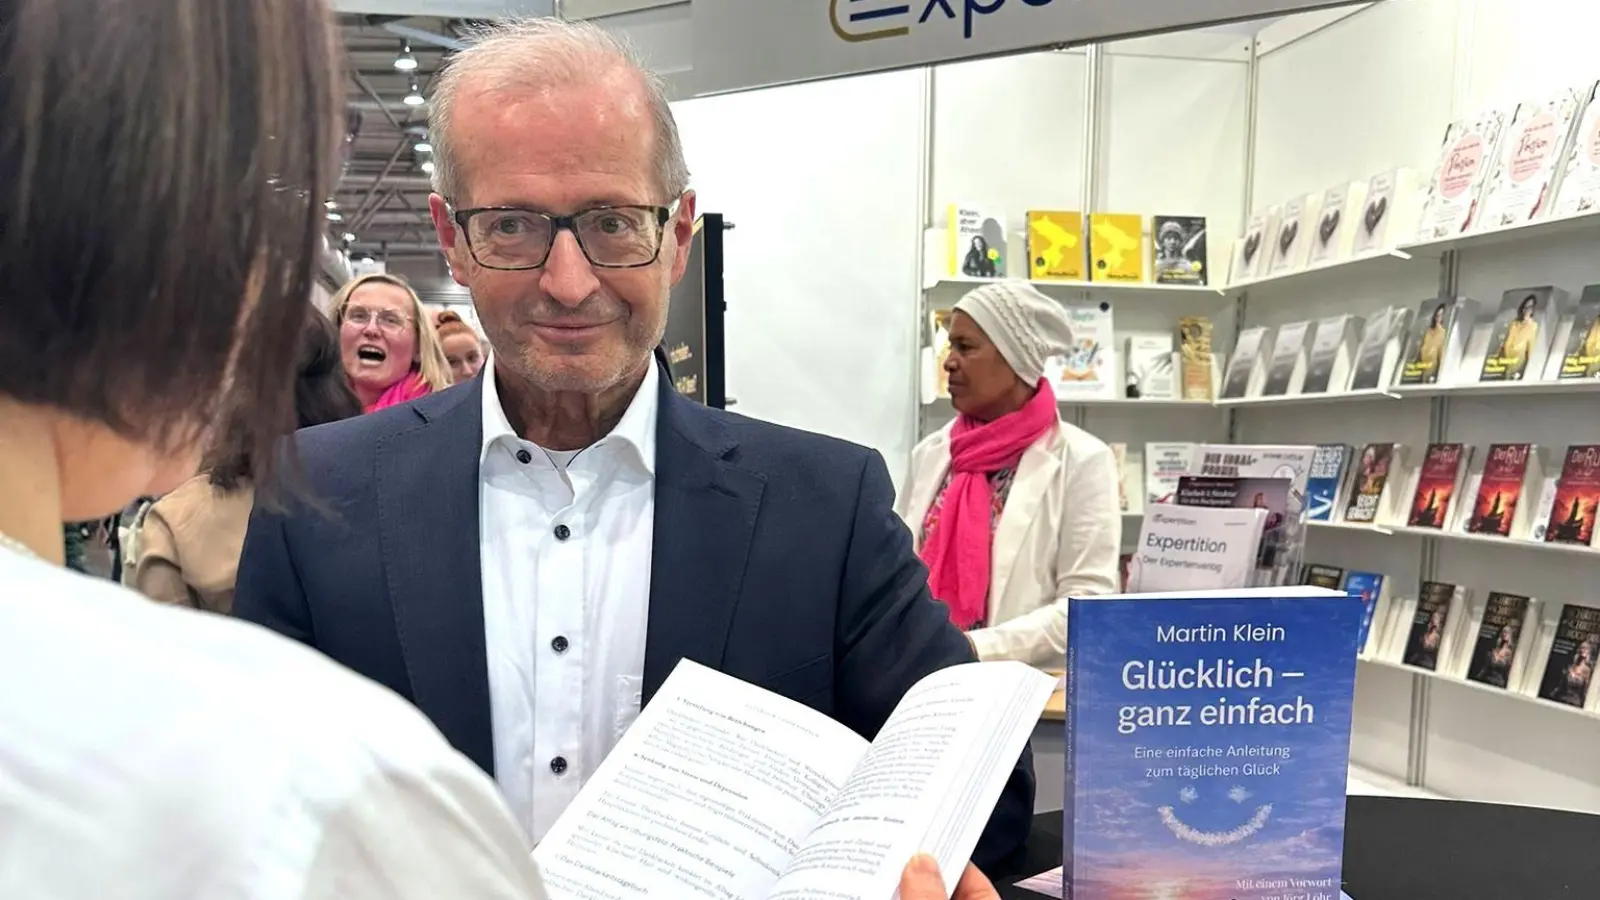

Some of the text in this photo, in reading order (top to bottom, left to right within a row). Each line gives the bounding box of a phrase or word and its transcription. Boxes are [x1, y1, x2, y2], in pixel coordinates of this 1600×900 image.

[829, 0, 1052, 42] Exp
[1505, 445, 1526, 465] Ruf
[1584, 447, 1600, 466] Ru
[1146, 532, 1227, 554] Expertition
[1143, 555, 1222, 573] Der Expertenverlag
[1156, 623, 1285, 643] Martin Klein
[1122, 659, 1273, 690] Glücklich
[1117, 695, 1314, 734] ganz einfach
[1134, 745, 1290, 760] Eine einfache Anleitung
[1146, 763, 1280, 779] zum täglichen Glück
[1236, 877, 1332, 890] Mit einem Vorwort
